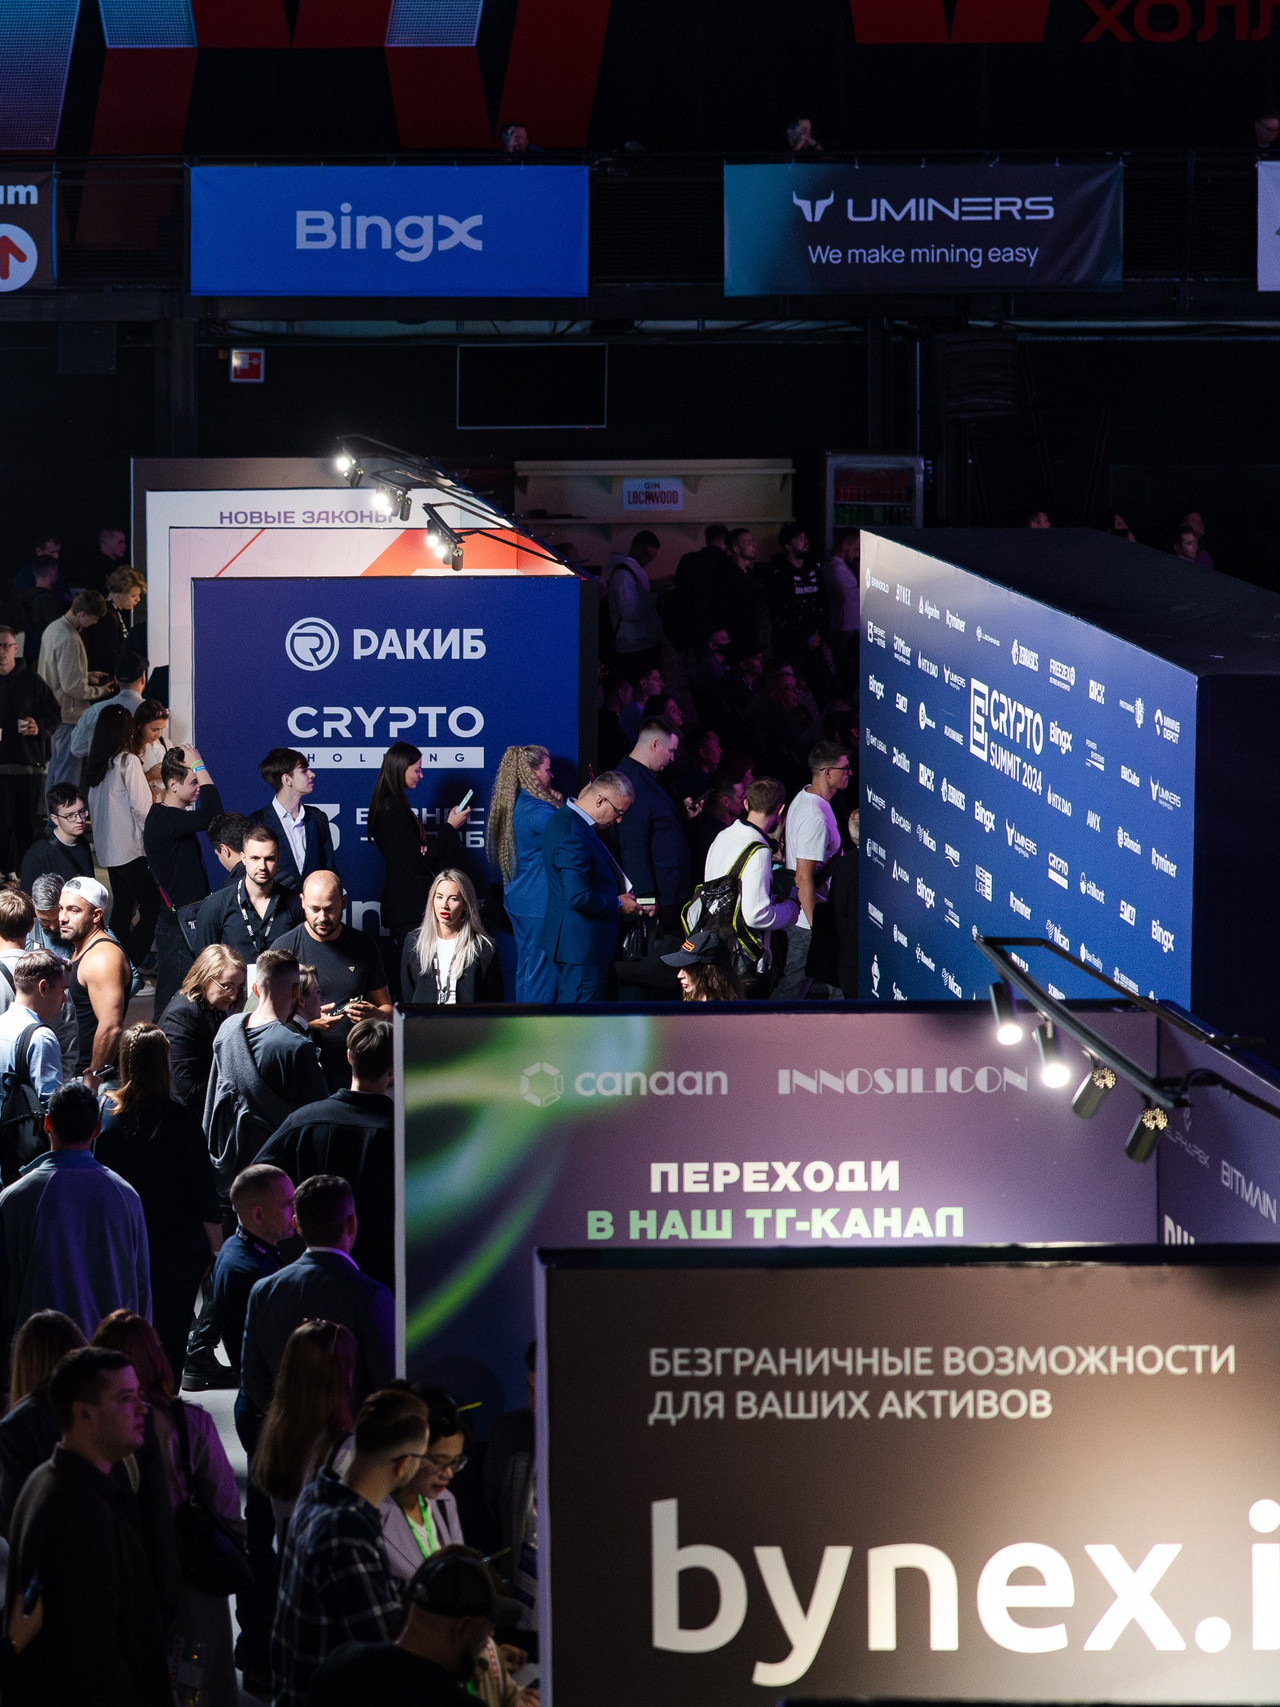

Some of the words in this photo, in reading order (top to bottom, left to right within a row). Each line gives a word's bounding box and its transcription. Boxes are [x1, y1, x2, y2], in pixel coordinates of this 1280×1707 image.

[847, 197, 1054, 222] UMINERS
[296, 203, 482, 261] Bingx
[808, 245, 841, 265] We
[847, 244, 904, 265] make
[910, 244, 982, 270] mining
[988, 248, 1038, 270] easy
[220, 511, 295, 524] НОВЫЕ
[353, 628, 486, 660] РАКИБ
[287, 706, 484, 738] CRYPTO
[990, 689, 1044, 755] CRYPTO
[1049, 721, 1073, 754] Bingx
[990, 742, 1021, 782] SUMMIT
[1022, 762, 1042, 795] 2024
[1152, 920, 1175, 953] Bingx
[575, 1070, 728, 1096] canaan
[778, 1067, 1028, 1095] INNOSILICON
[650, 1161, 900, 1193] ПЕРЕХОДИ
[1221, 1160, 1278, 1225] BITMAIN
[586, 1211, 615, 1240] В
[629, 1209, 732, 1240] НАШ
[745, 1207, 965, 1240] ТГ-КАНАЛ
[649, 1347, 933, 1377] БЕЗГРАНИЧНЫЕ
[944, 1345, 1236, 1375] ВОЗМОЖНОСТИ
[649, 1391, 725, 1425] ДЛЯ
[735, 1391, 870, 1421] ВАШИХ
[878, 1390, 1053, 1419] АКТИВОВ
